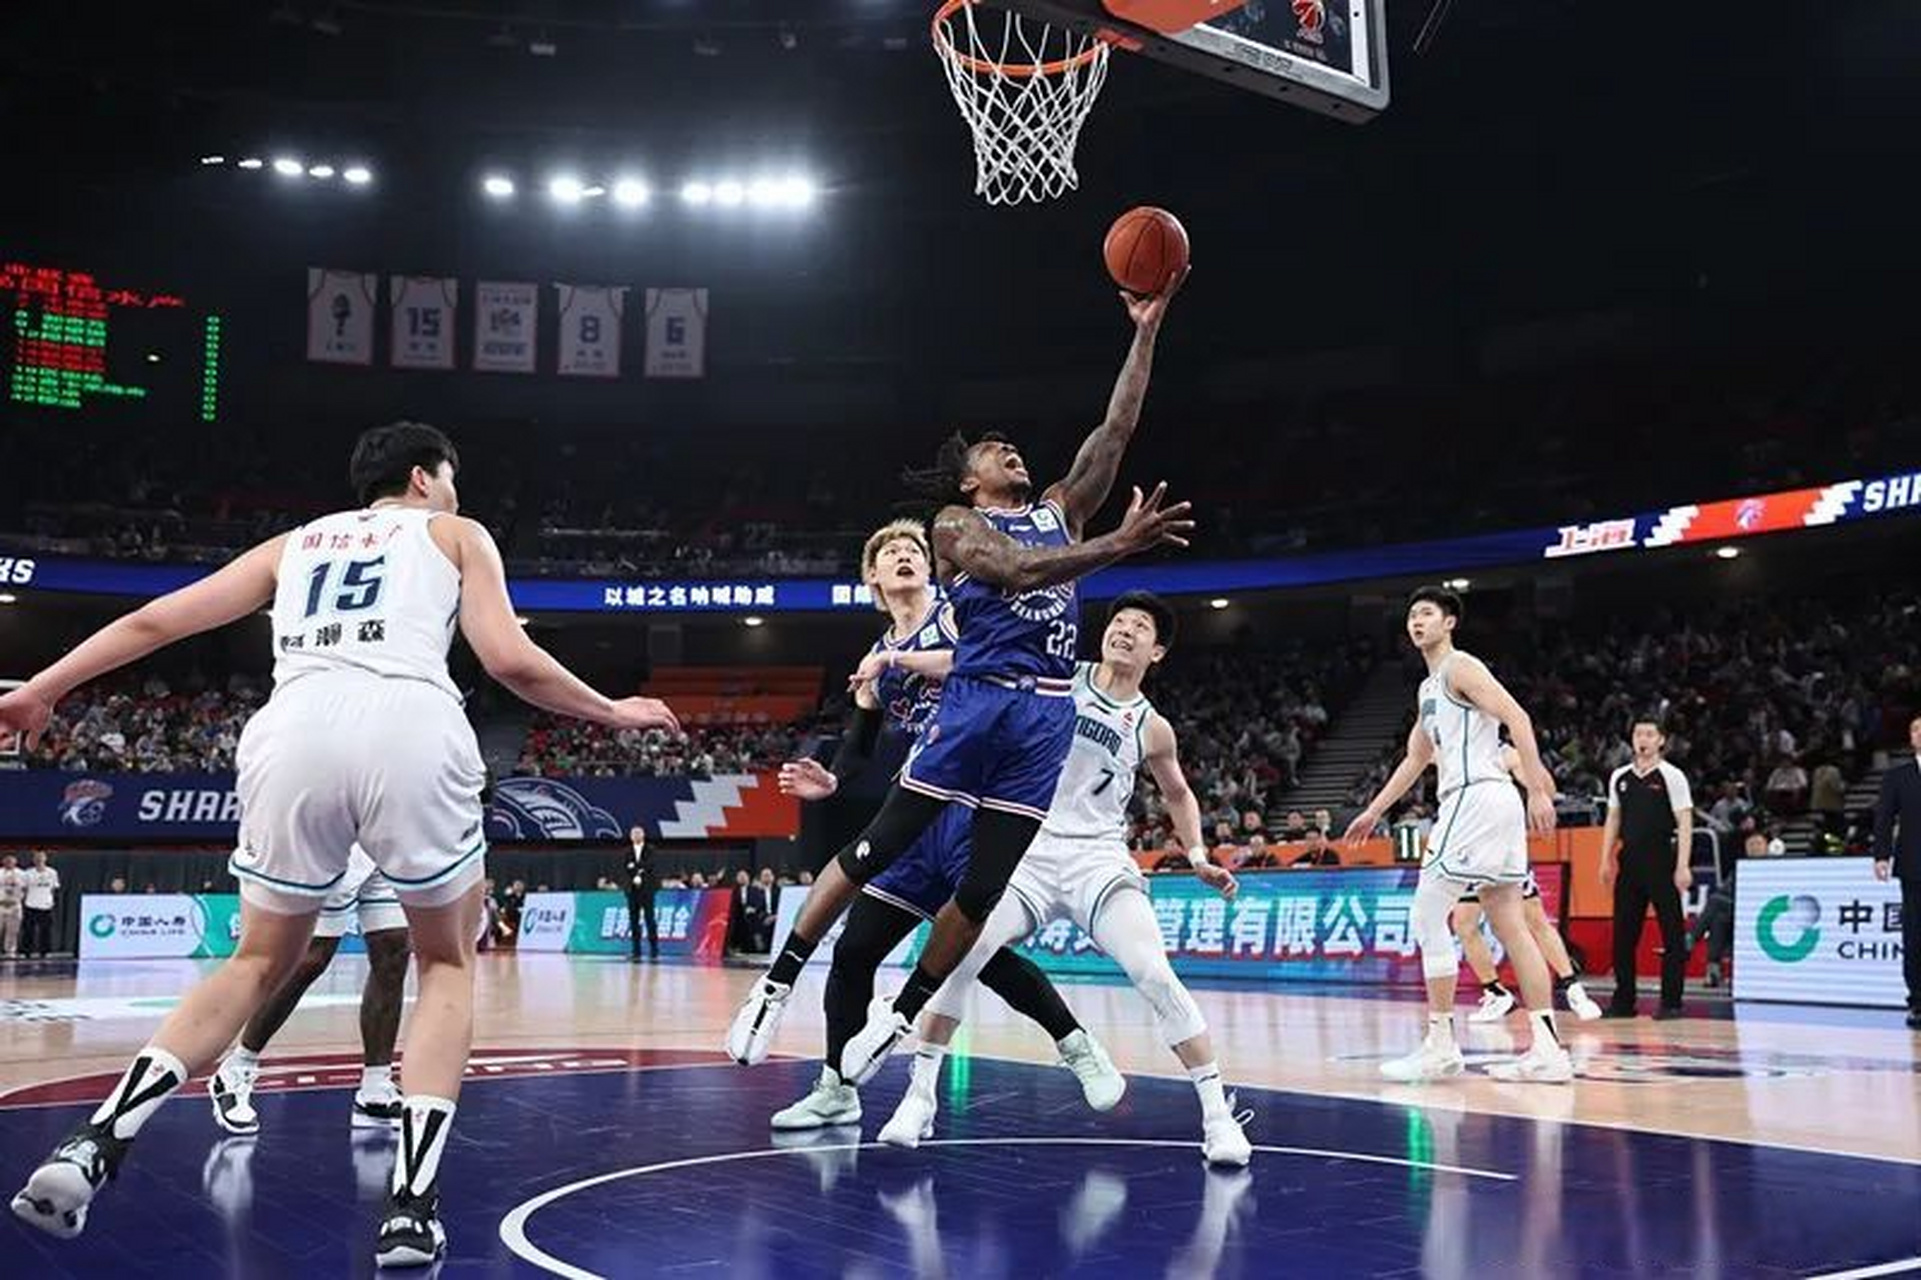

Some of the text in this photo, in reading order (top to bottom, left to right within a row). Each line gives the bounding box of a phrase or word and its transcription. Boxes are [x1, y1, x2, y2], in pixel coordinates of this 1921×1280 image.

[407, 307, 441, 337] 15
[580, 315, 601, 344] 8
[666, 316, 686, 346] 6
[304, 555, 385, 619] 15
[1046, 619, 1078, 661] 22
[1092, 768, 1114, 795] 7
